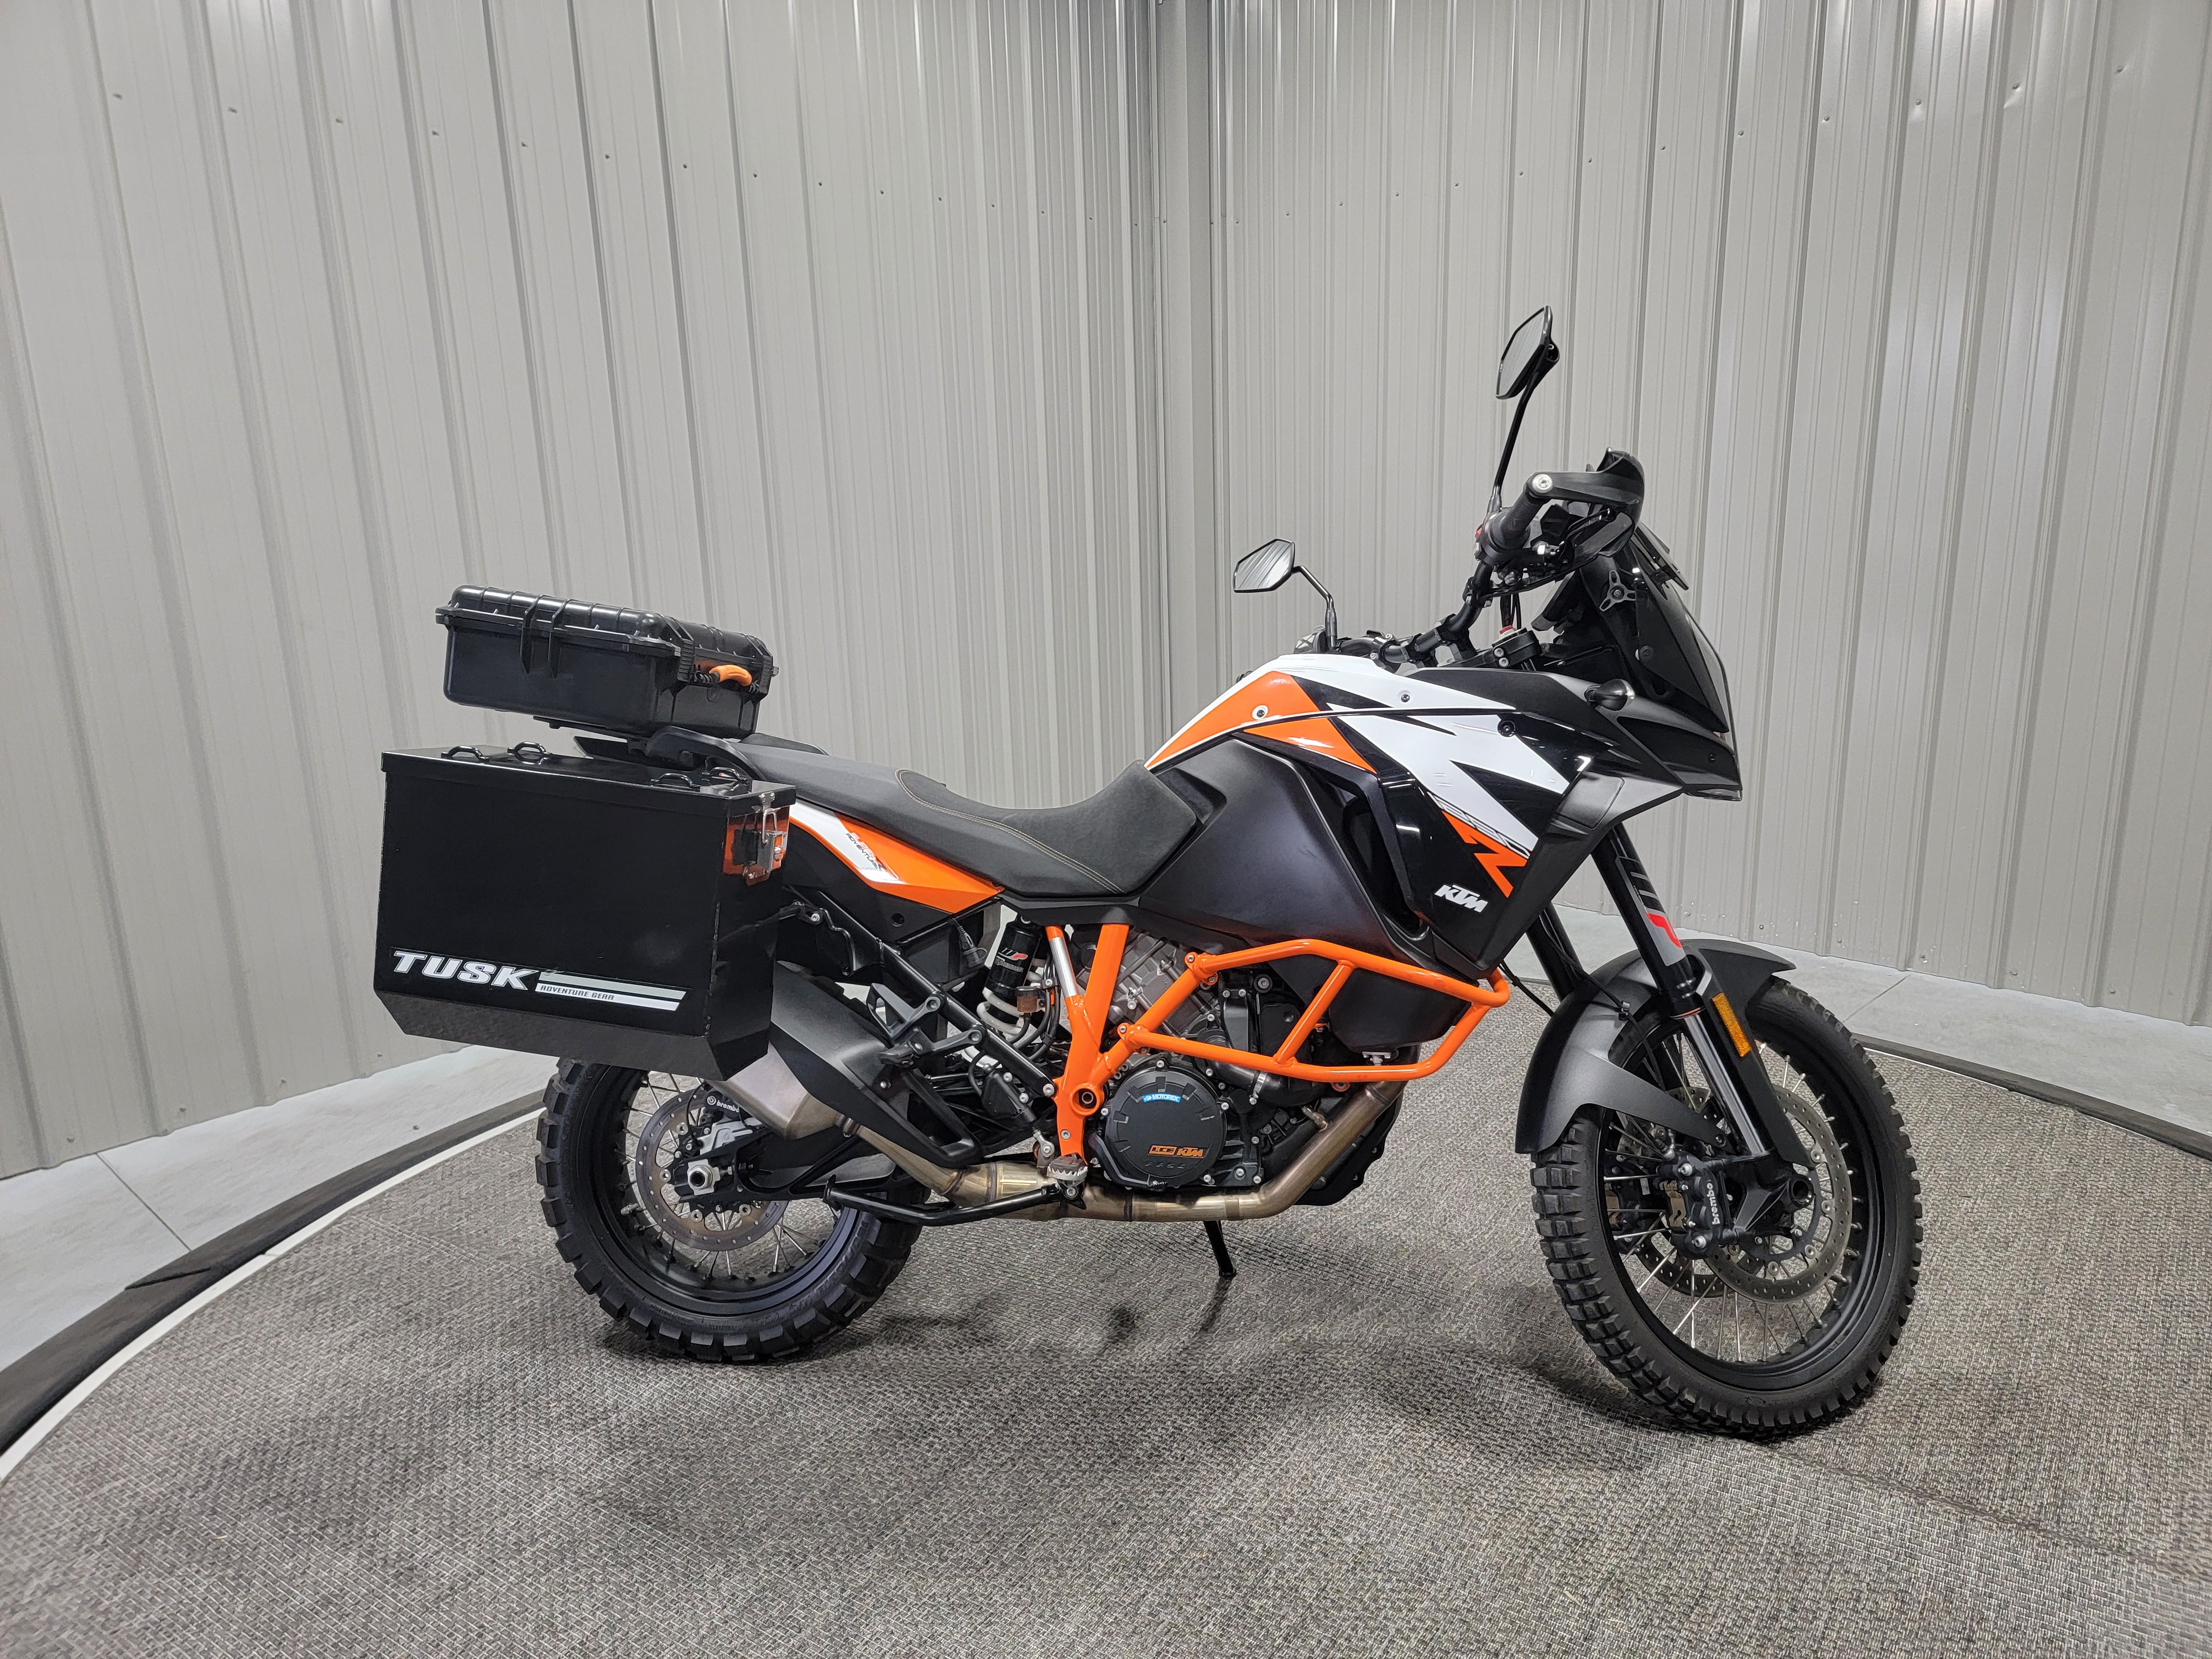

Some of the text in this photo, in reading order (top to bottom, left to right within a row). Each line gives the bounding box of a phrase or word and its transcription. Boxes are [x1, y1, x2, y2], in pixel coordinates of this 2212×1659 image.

[1434, 884, 1488, 913] KTM
[393, 950, 539, 990] TUSK
[540, 985, 614, 1001] ADVENTURE GEAR
[1152, 1093, 1178, 1102] MOTOREX
[716, 1099, 739, 1113] brembo
[1176, 1147, 1204, 1157] KTM
[1707, 1182, 1720, 1225] brembo
